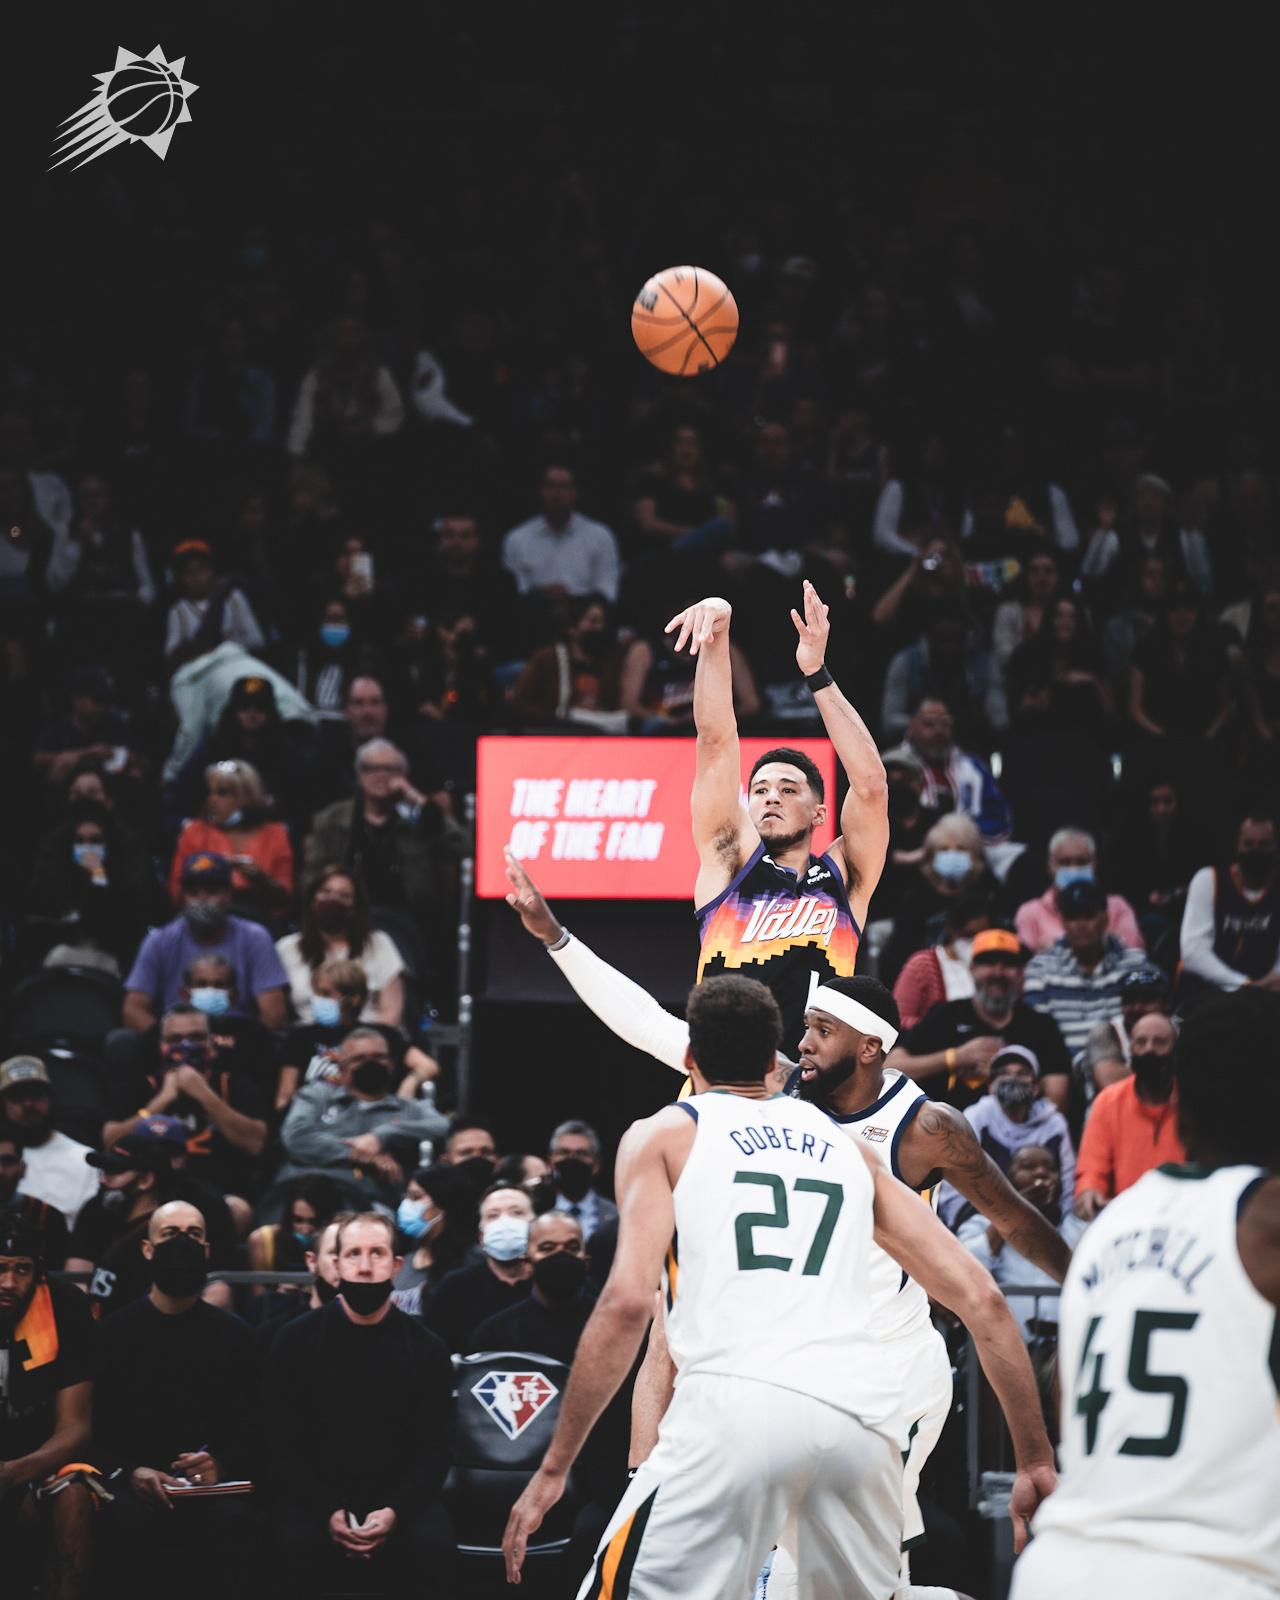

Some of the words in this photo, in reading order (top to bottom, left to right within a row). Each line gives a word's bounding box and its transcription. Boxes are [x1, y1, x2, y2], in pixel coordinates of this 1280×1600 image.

[512, 779, 563, 817] THE
[564, 779, 658, 818] HEART
[510, 821, 548, 861] OF
[551, 821, 605, 860] THE
[606, 821, 665, 861] FAN
[806, 871, 832, 885] PayPal
[741, 898, 838, 947] Valley
[773, 902, 796, 912] THE
[729, 1125, 835, 1163] GOBERT
[732, 1170, 845, 1276] 27
[1074, 1309, 1203, 1458] 45
